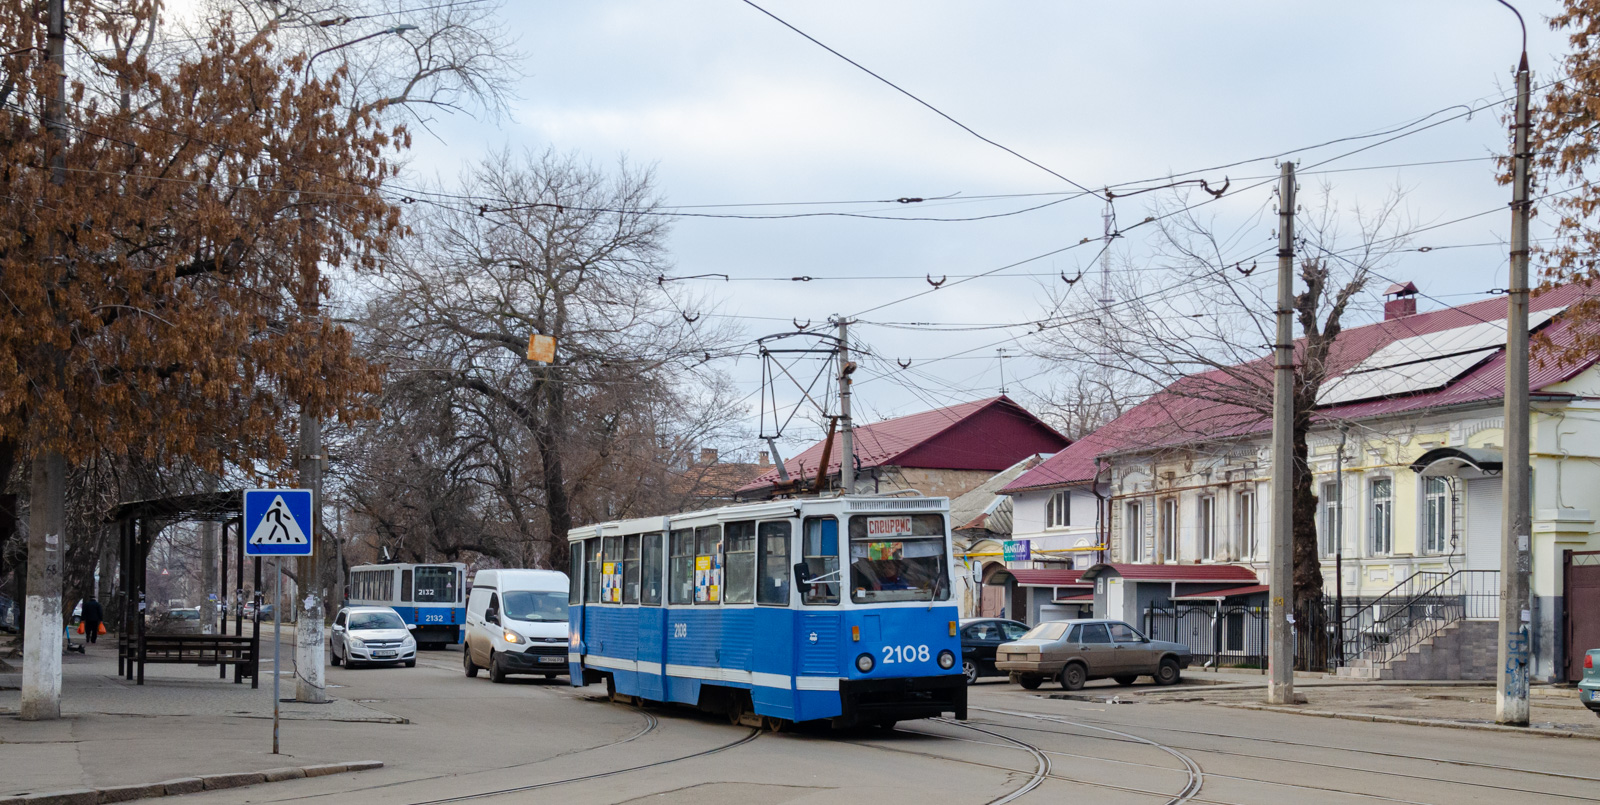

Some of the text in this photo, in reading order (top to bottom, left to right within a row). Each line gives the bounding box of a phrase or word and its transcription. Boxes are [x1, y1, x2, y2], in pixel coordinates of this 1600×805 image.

[425, 614, 443, 622] 2132
[674, 623, 687, 638] 2108
[882, 644, 930, 664] 2108
